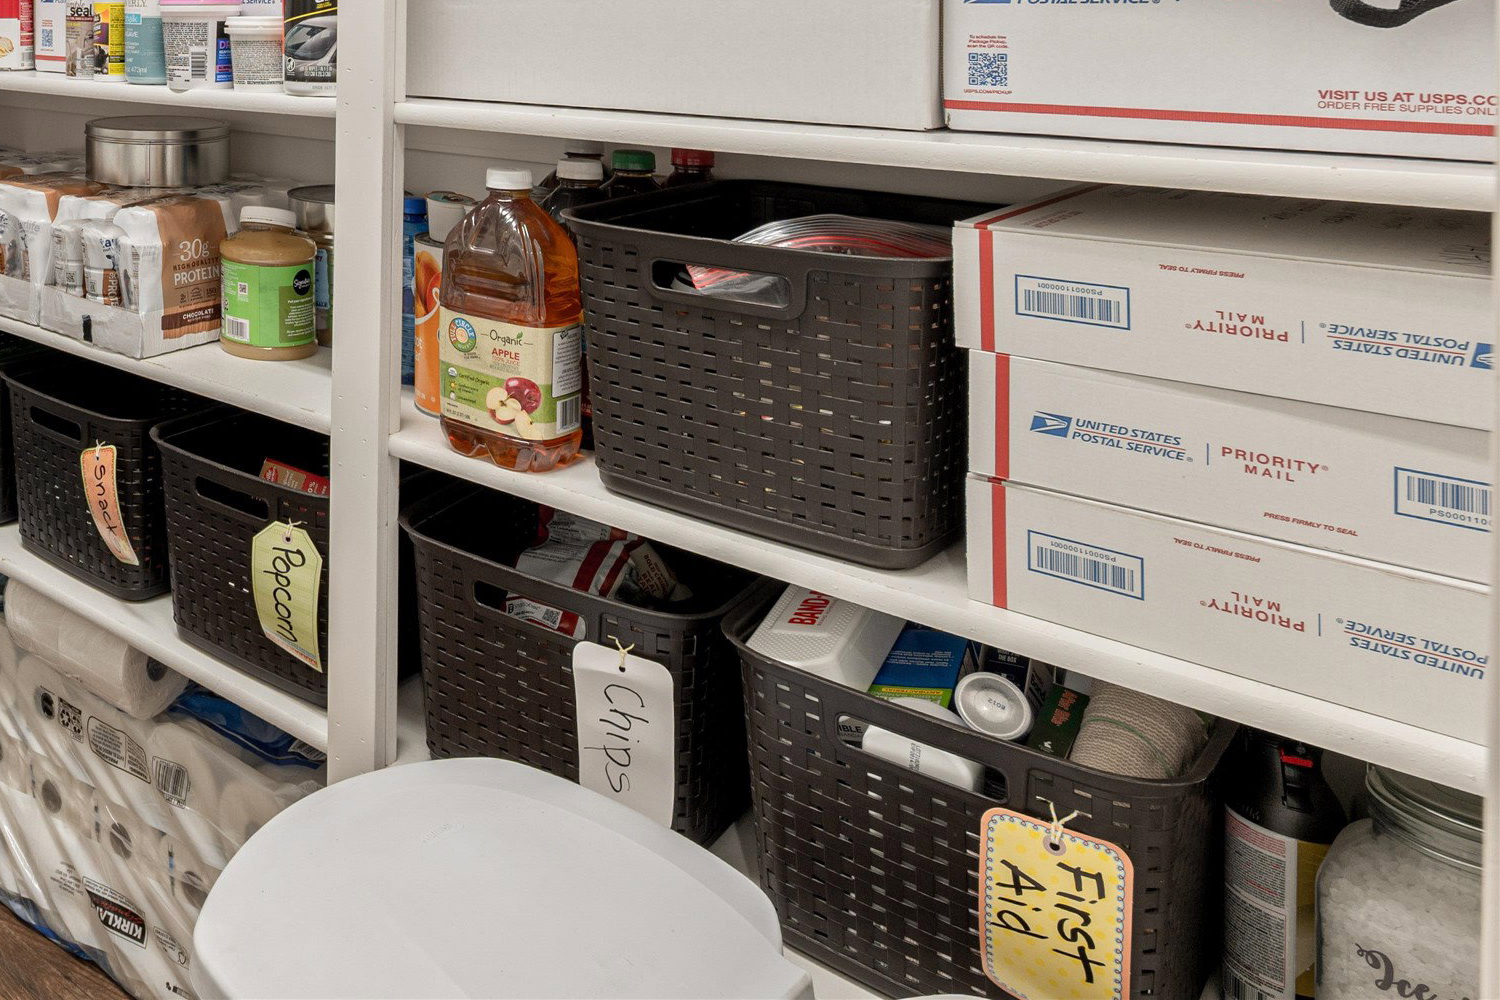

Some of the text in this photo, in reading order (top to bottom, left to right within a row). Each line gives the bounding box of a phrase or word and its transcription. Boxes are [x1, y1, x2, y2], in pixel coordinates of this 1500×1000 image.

[70, 3, 93, 17] seal
[1317, 100, 1360, 111] ORDER
[1363, 102, 1396, 112] FREE
[1398, 103, 1462, 115] SUPPLIES
[1318, 88, 1361, 102] VISIT
[1364, 90, 1389, 103] US
[1392, 91, 1416, 104] AT
[179, 239, 210, 262] 30g
[174, 266, 220, 286] PROTEIN
[1158, 262, 1245, 279] PRESS FIRMLY TO SEAL
[1215, 309, 1266, 326] MAIL
[490, 329, 523, 347] Organic
[1193, 320, 1290, 343] PRIORITY
[1327, 322, 1470, 350] POSTAL SERVICE
[491, 347, 520, 361] APPLE
[1332, 338, 1465, 367] UNITED STATES
[1074, 417, 1181, 447] UNITED STATES
[1072, 431, 1185, 462] POSTAL SERVICE
[1221, 445, 1322, 474] PRIORITY
[1244, 464, 1296, 483] MAIL
[1264, 511, 1359, 537] PRESS FIRMLY TO SEAL
[1173, 536, 1261, 563] PRESS FIRMLY TO SEAL
[1231, 591, 1281, 612] MAIL
[1207, 598, 1306, 633] PRIORITY
[1344, 618, 1489, 664] POSTAL SERVICE
[1349, 636, 1485, 680] UNITED STATES
[584, 683, 648, 794] Chips
[987, 857, 1047, 943] Aid
[1054, 860, 1111, 986] First
